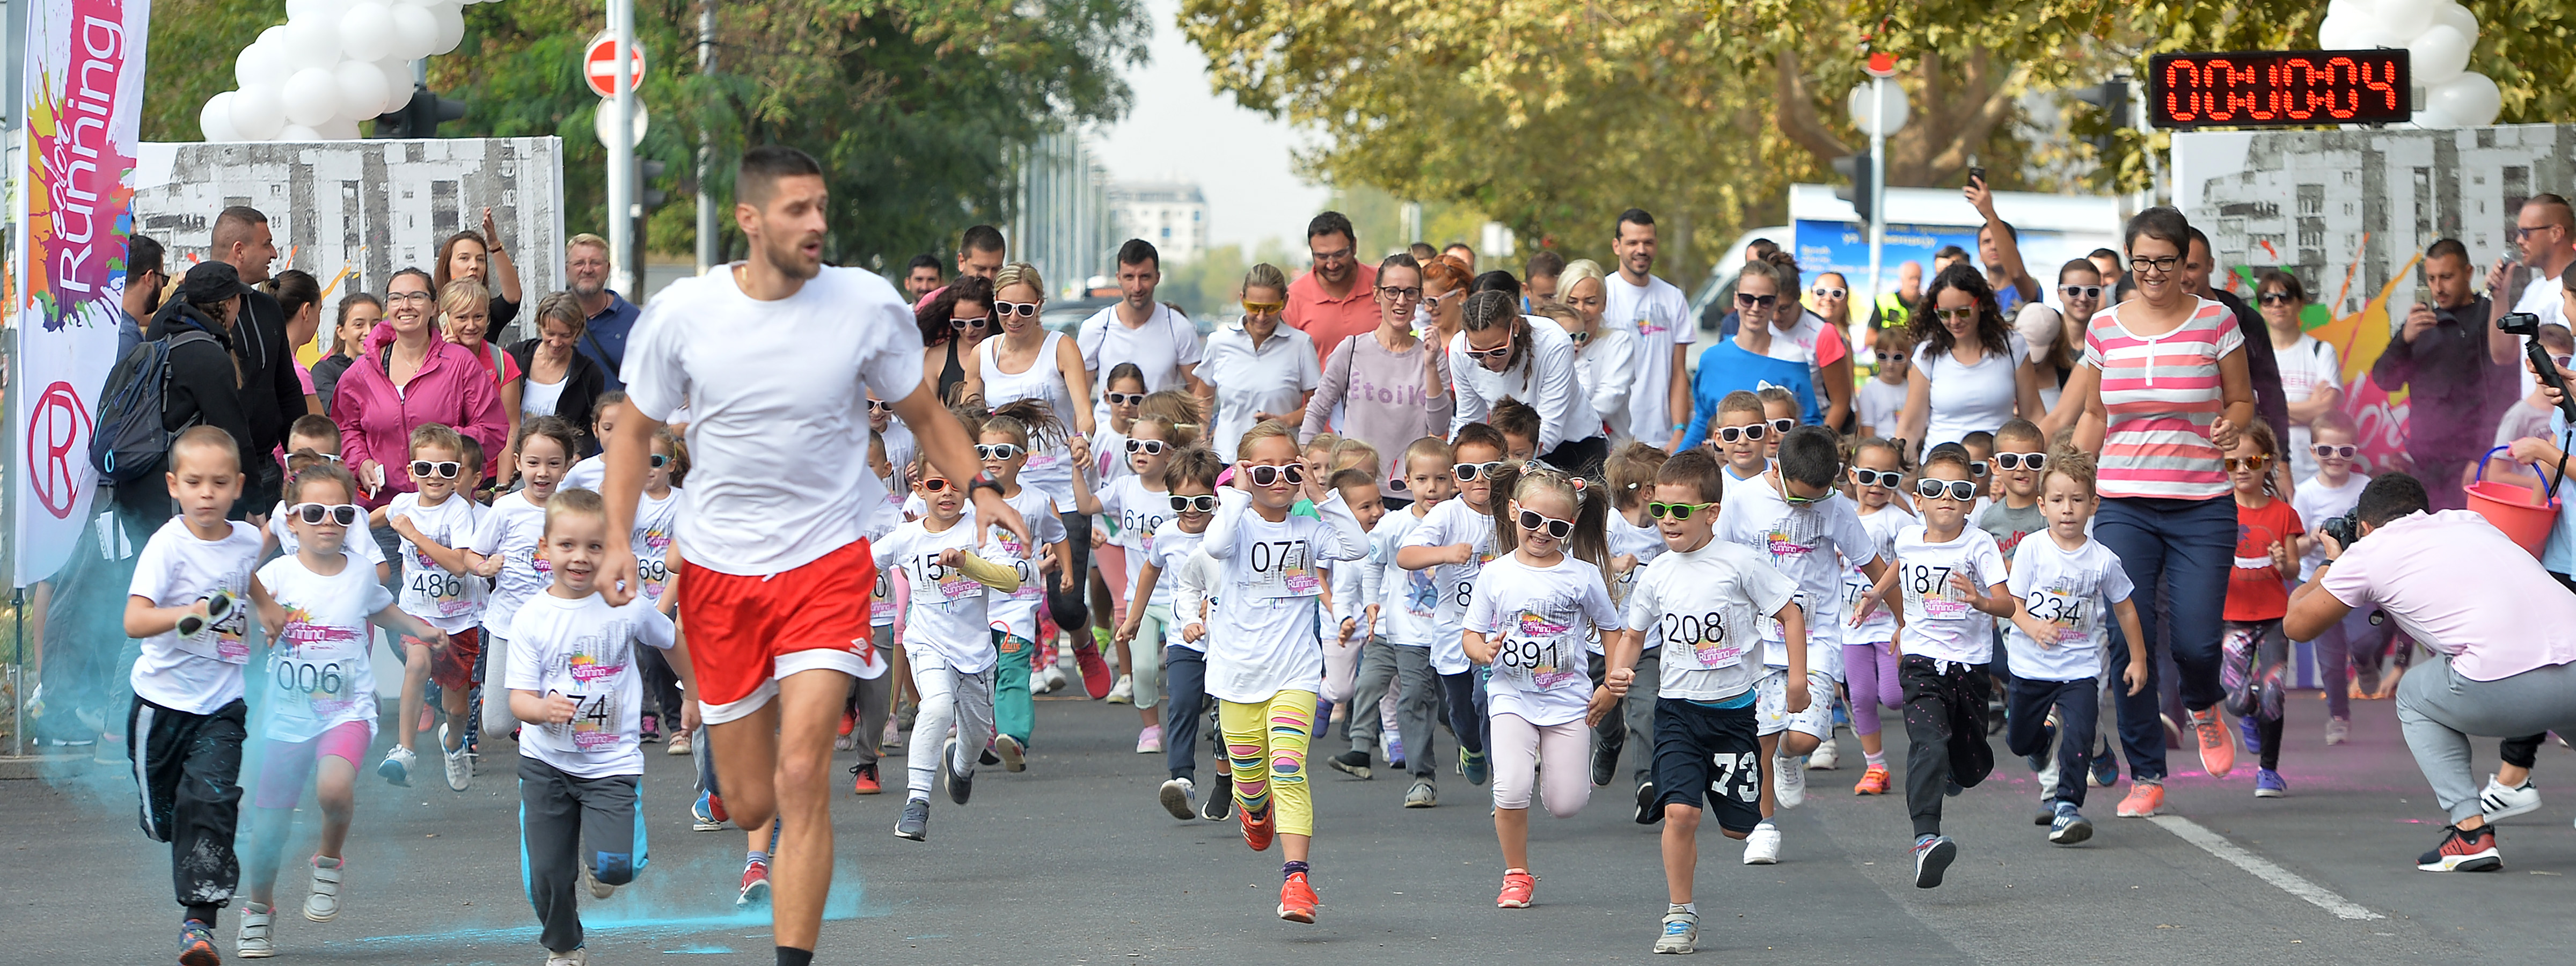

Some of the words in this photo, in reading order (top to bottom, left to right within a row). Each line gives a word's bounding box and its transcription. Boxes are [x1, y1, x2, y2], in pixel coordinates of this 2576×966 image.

[59, 15, 127, 293] Running
[40, 119, 71, 240] color
[1251, 540, 1306, 573] 077
[1770, 543, 1797, 552] Running
[912, 553, 951, 581] 15
[1901, 563, 1951, 595] 187
[412, 574, 460, 598] 486
[942, 583, 971, 595] Running
[1924, 602, 1953, 611] Running
[2028, 591, 2081, 625] 234
[1522, 624, 1552, 633] Running
[1665, 612, 1724, 645] 208
[1502, 639, 1557, 669] 891
[1698, 650, 1730, 661] Running
[277, 661, 341, 694] 006
[572, 669, 606, 677] Running
[1535, 675, 1563, 684] Running
[547, 689, 608, 725] 74
[575, 734, 608, 744] Running
[1711, 751, 1759, 802] 73
